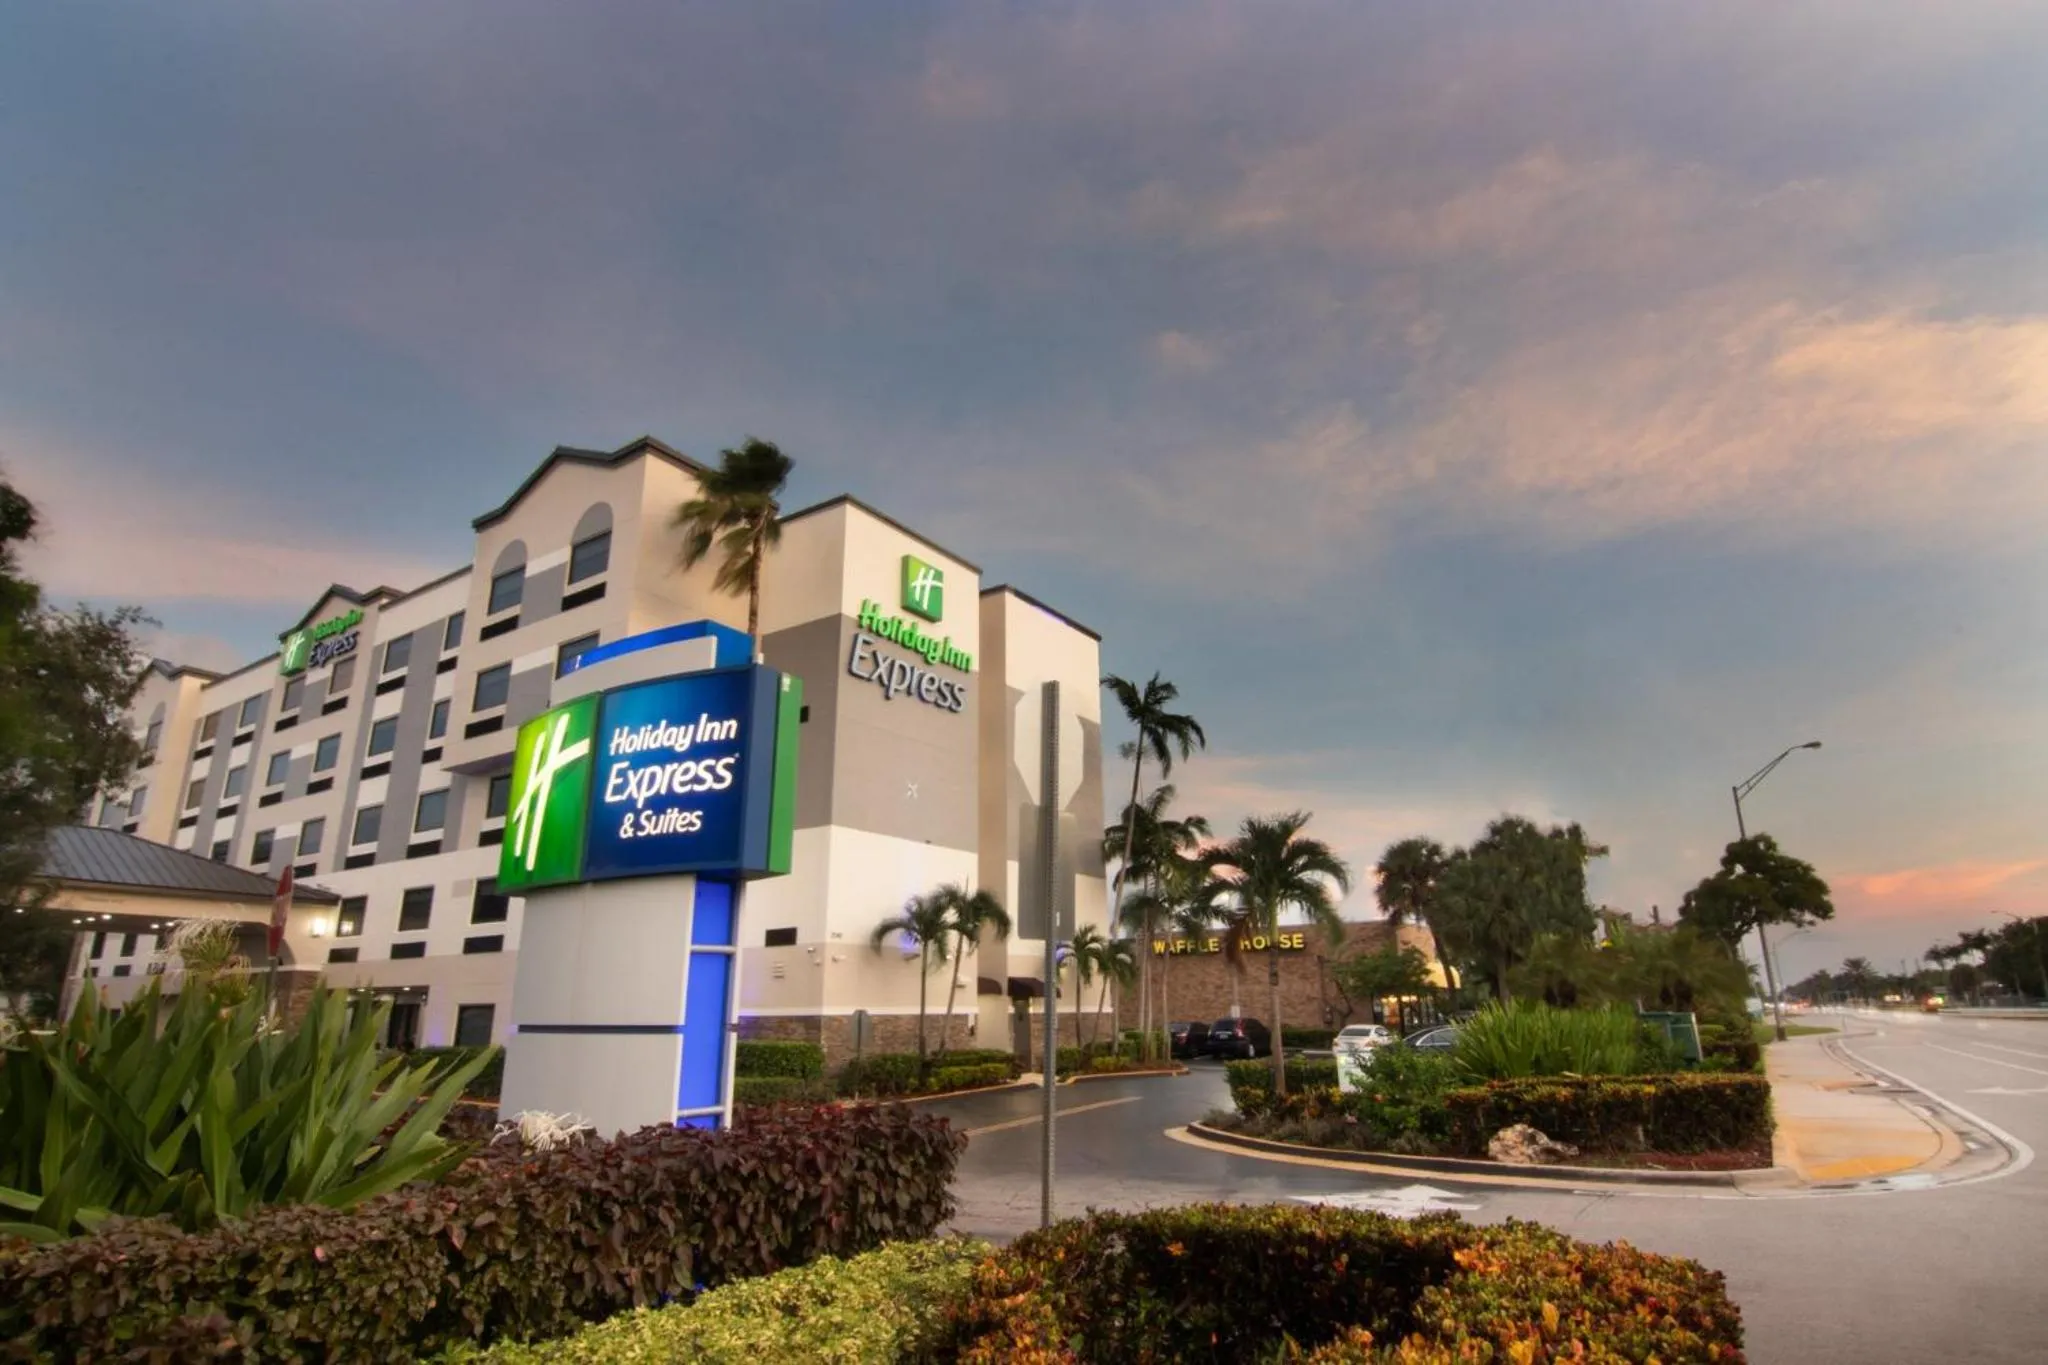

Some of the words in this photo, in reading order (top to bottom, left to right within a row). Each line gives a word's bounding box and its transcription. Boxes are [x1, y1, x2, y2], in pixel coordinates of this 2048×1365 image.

[857, 598, 939, 666] Holiday
[941, 635, 973, 674] Inn
[848, 631, 967, 713] Express
[610, 719, 695, 756] Holiday
[696, 713, 738, 743] Inn
[604, 756, 736, 808] Express
[619, 813, 635, 839] &
[636, 807, 703, 837] Suites
